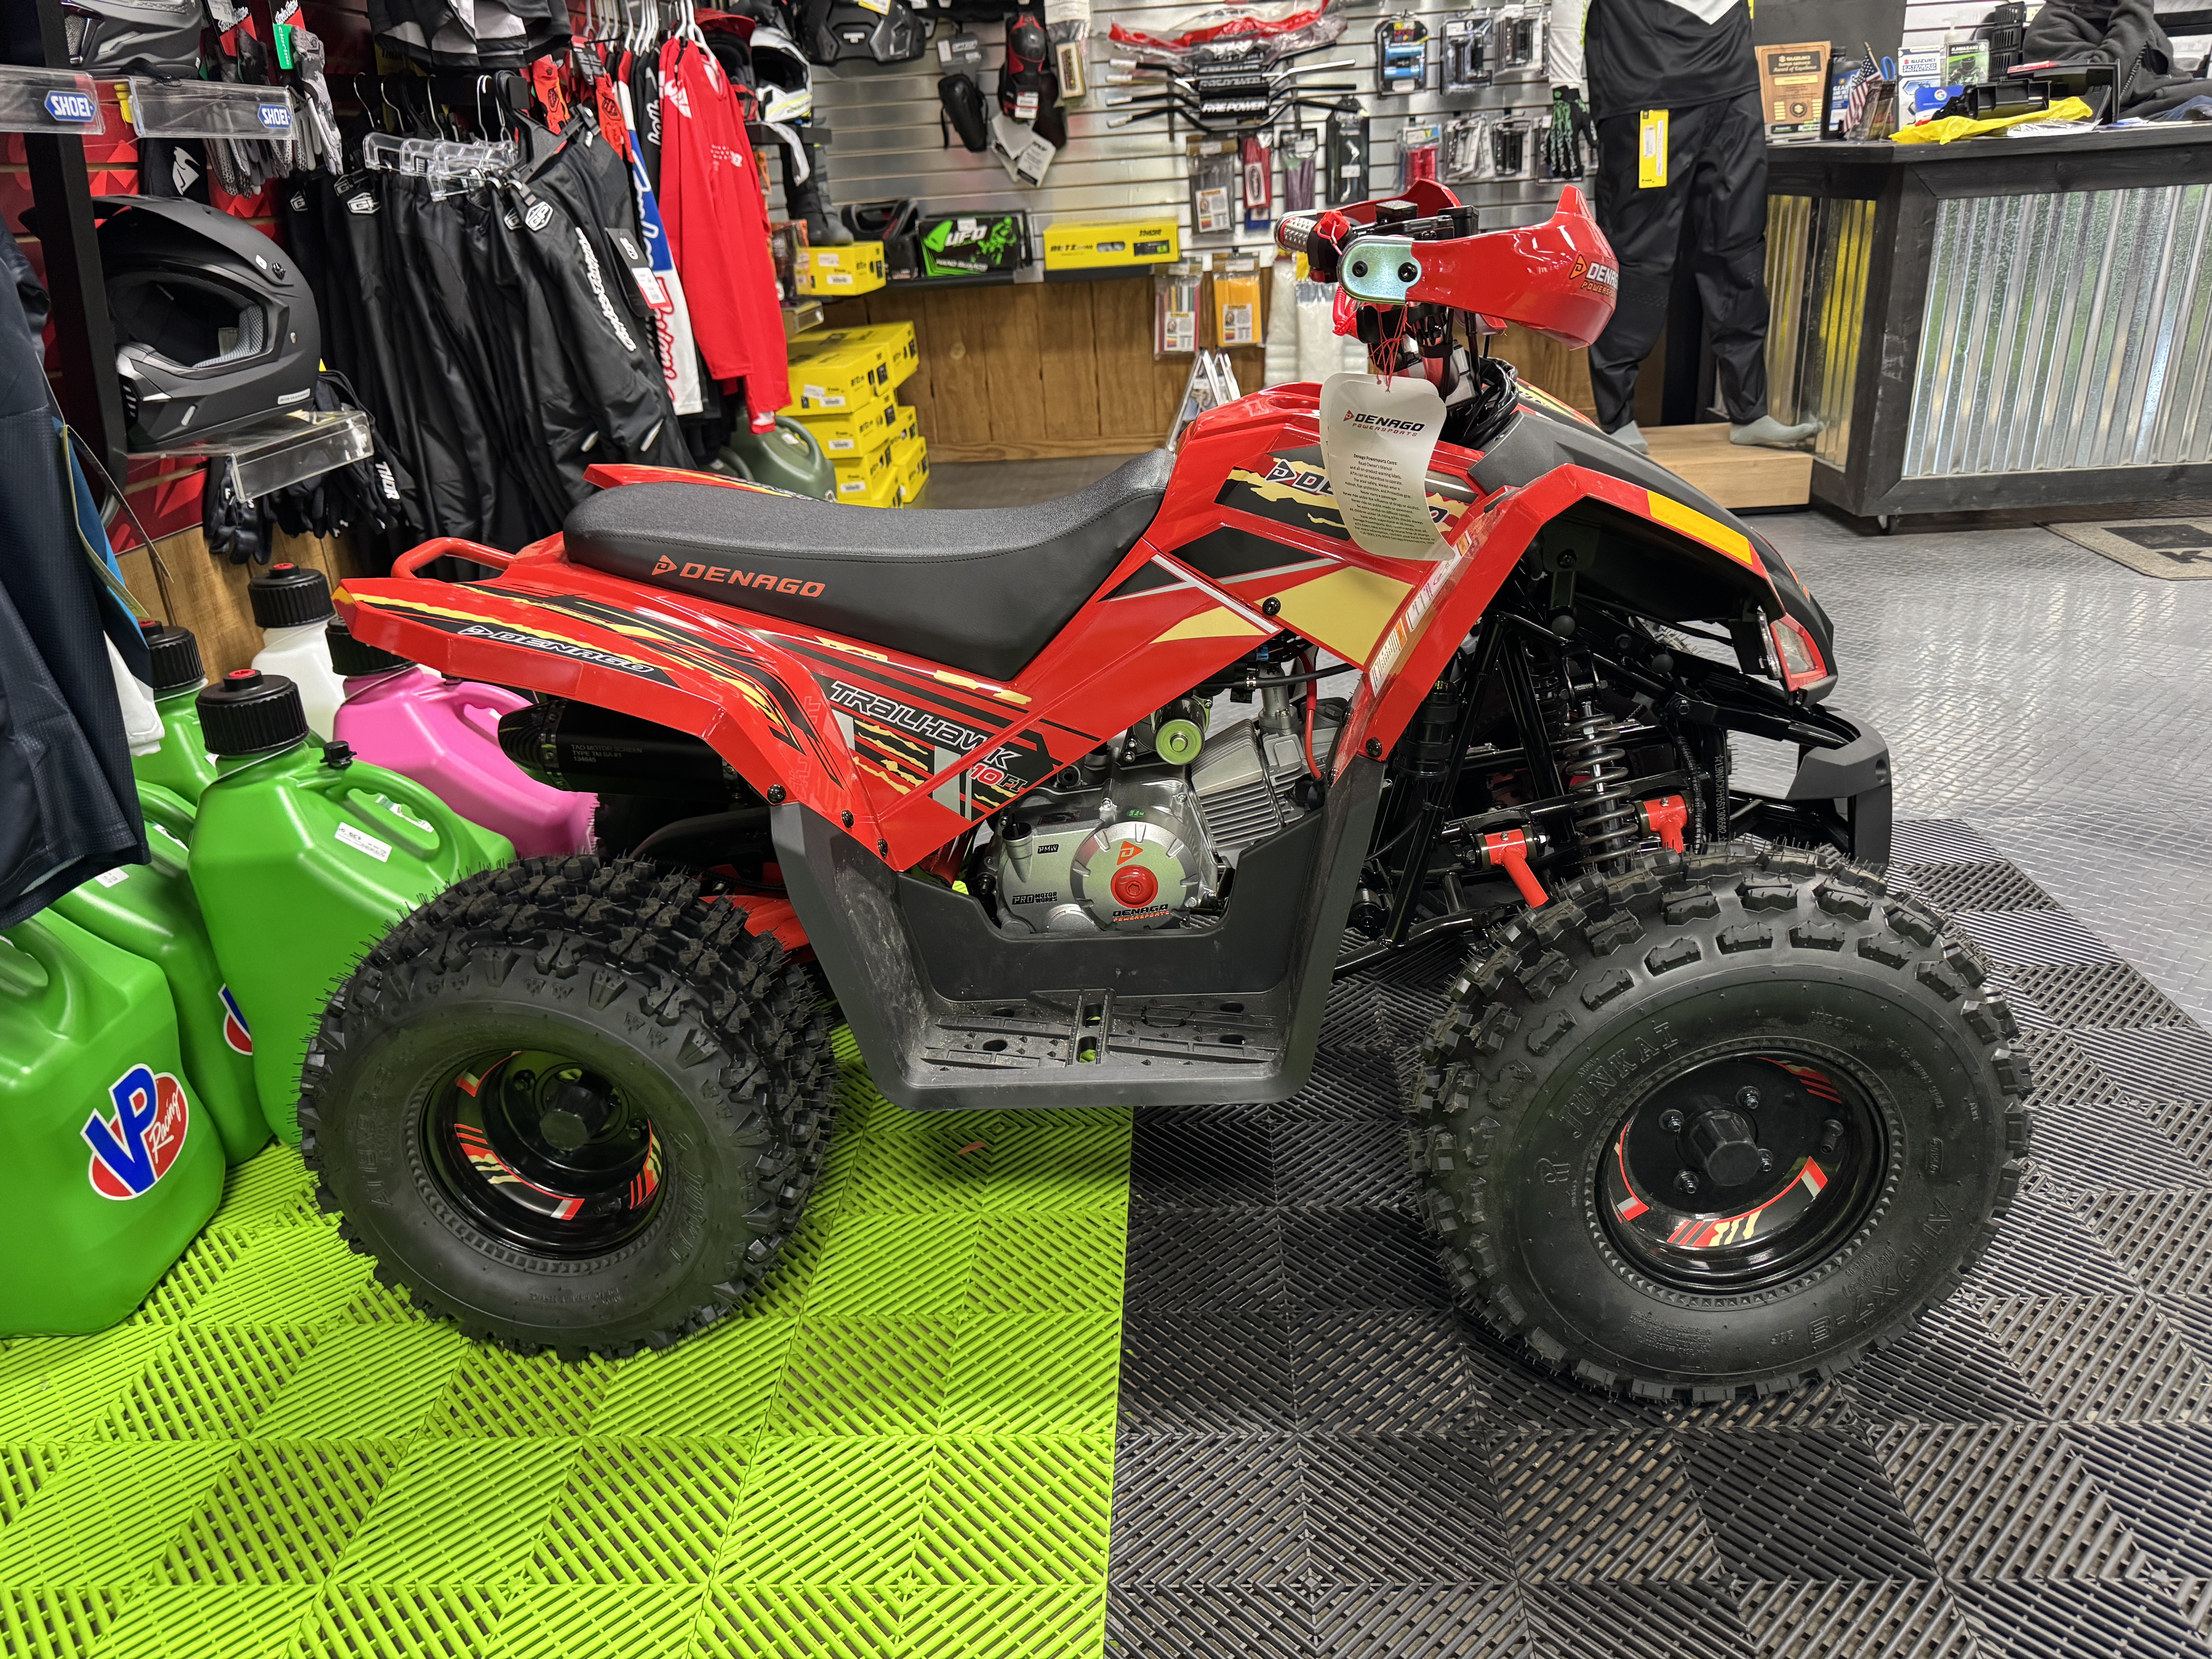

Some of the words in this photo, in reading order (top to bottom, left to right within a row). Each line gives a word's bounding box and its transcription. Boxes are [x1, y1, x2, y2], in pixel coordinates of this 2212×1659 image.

[52, 95, 92, 116] SHOEI
[261, 108, 289, 125] SHOEI
[945, 225, 988, 247] UFO
[1352, 423, 1418, 436] POWERSPORTS
[1354, 413, 1425, 432] DENAGO
[680, 562, 826, 598] DENAGO
[489, 630, 654, 673] DENAGO
[1039, 845, 1058, 853] PMW
[1013, 895, 1034, 904] PRO
[1113, 904, 1169, 917] DENAGO
[85, 1068, 158, 1194] VP
[149, 1085, 182, 1164] Racing
